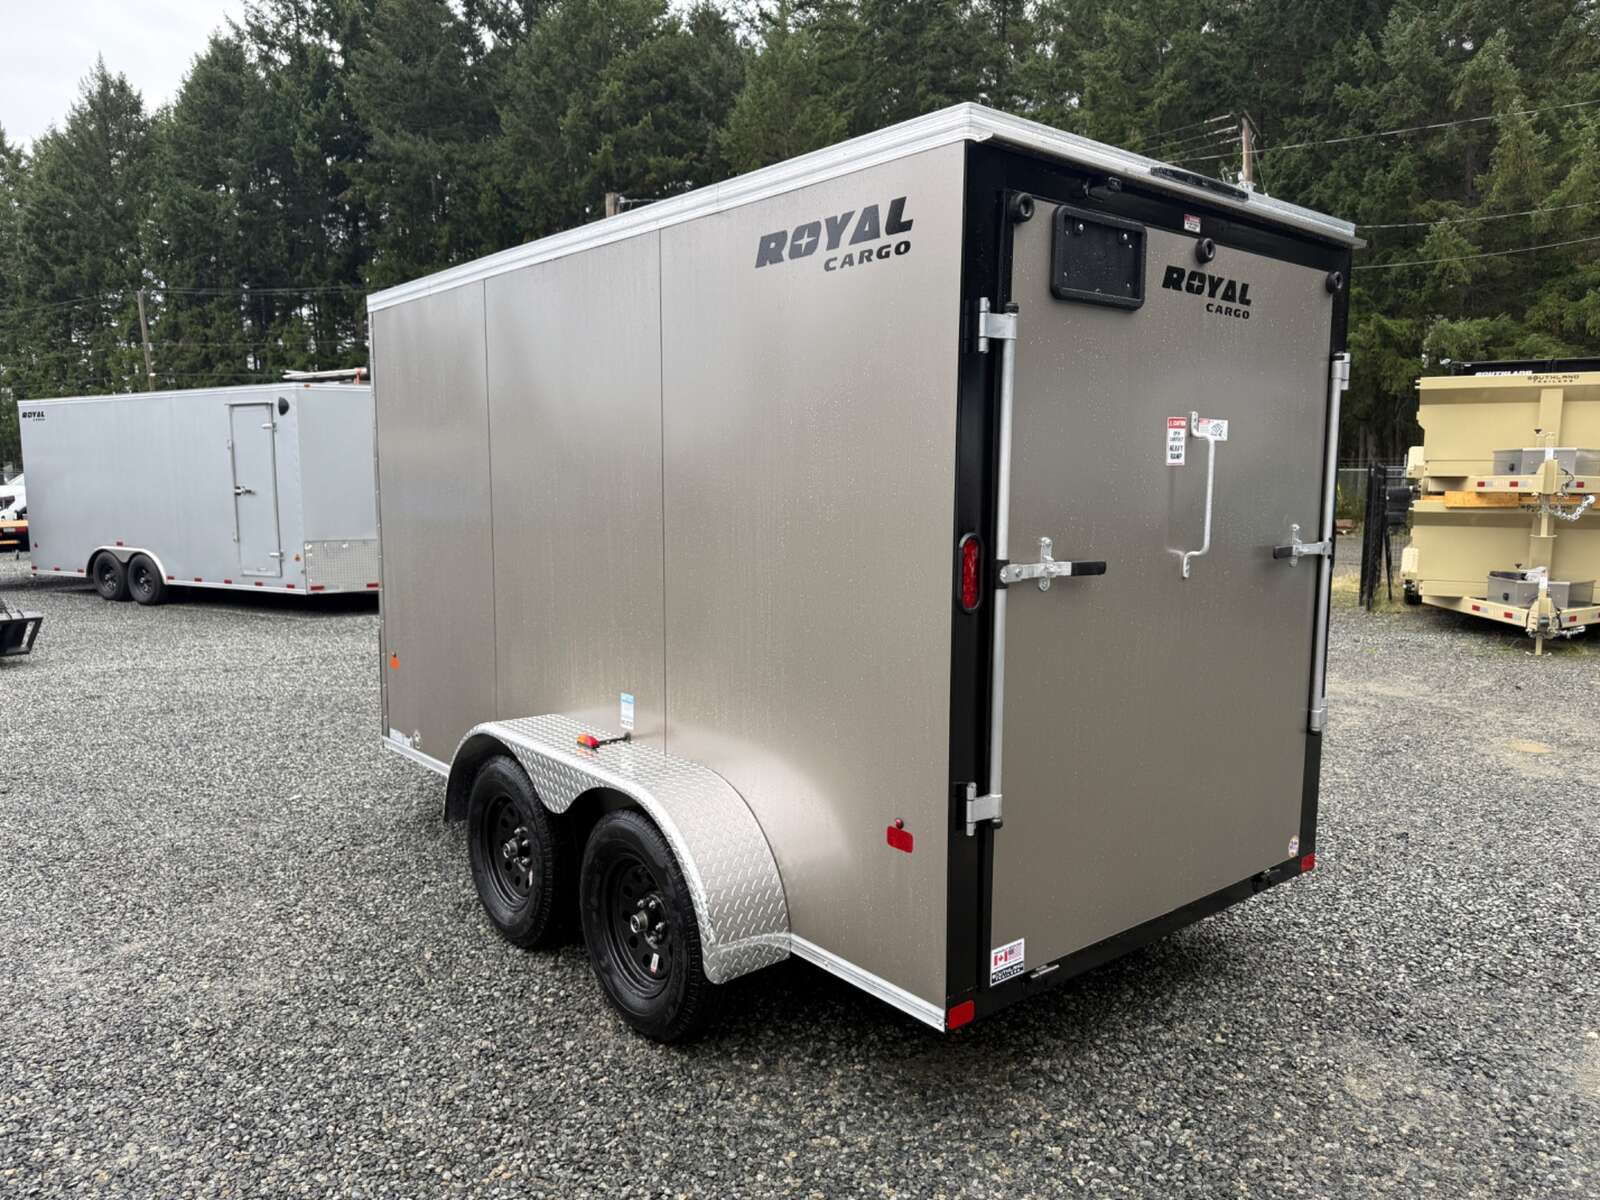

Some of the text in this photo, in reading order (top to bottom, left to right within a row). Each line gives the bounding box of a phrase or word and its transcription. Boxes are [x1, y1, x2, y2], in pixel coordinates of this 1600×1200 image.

[755, 196, 914, 268] ROYAL
[824, 240, 911, 272] CARGO
[1162, 265, 1252, 306] ROYAL
[1206, 303, 1250, 319] CARGO
[1527, 375, 1580, 383] SOUTHLAND
